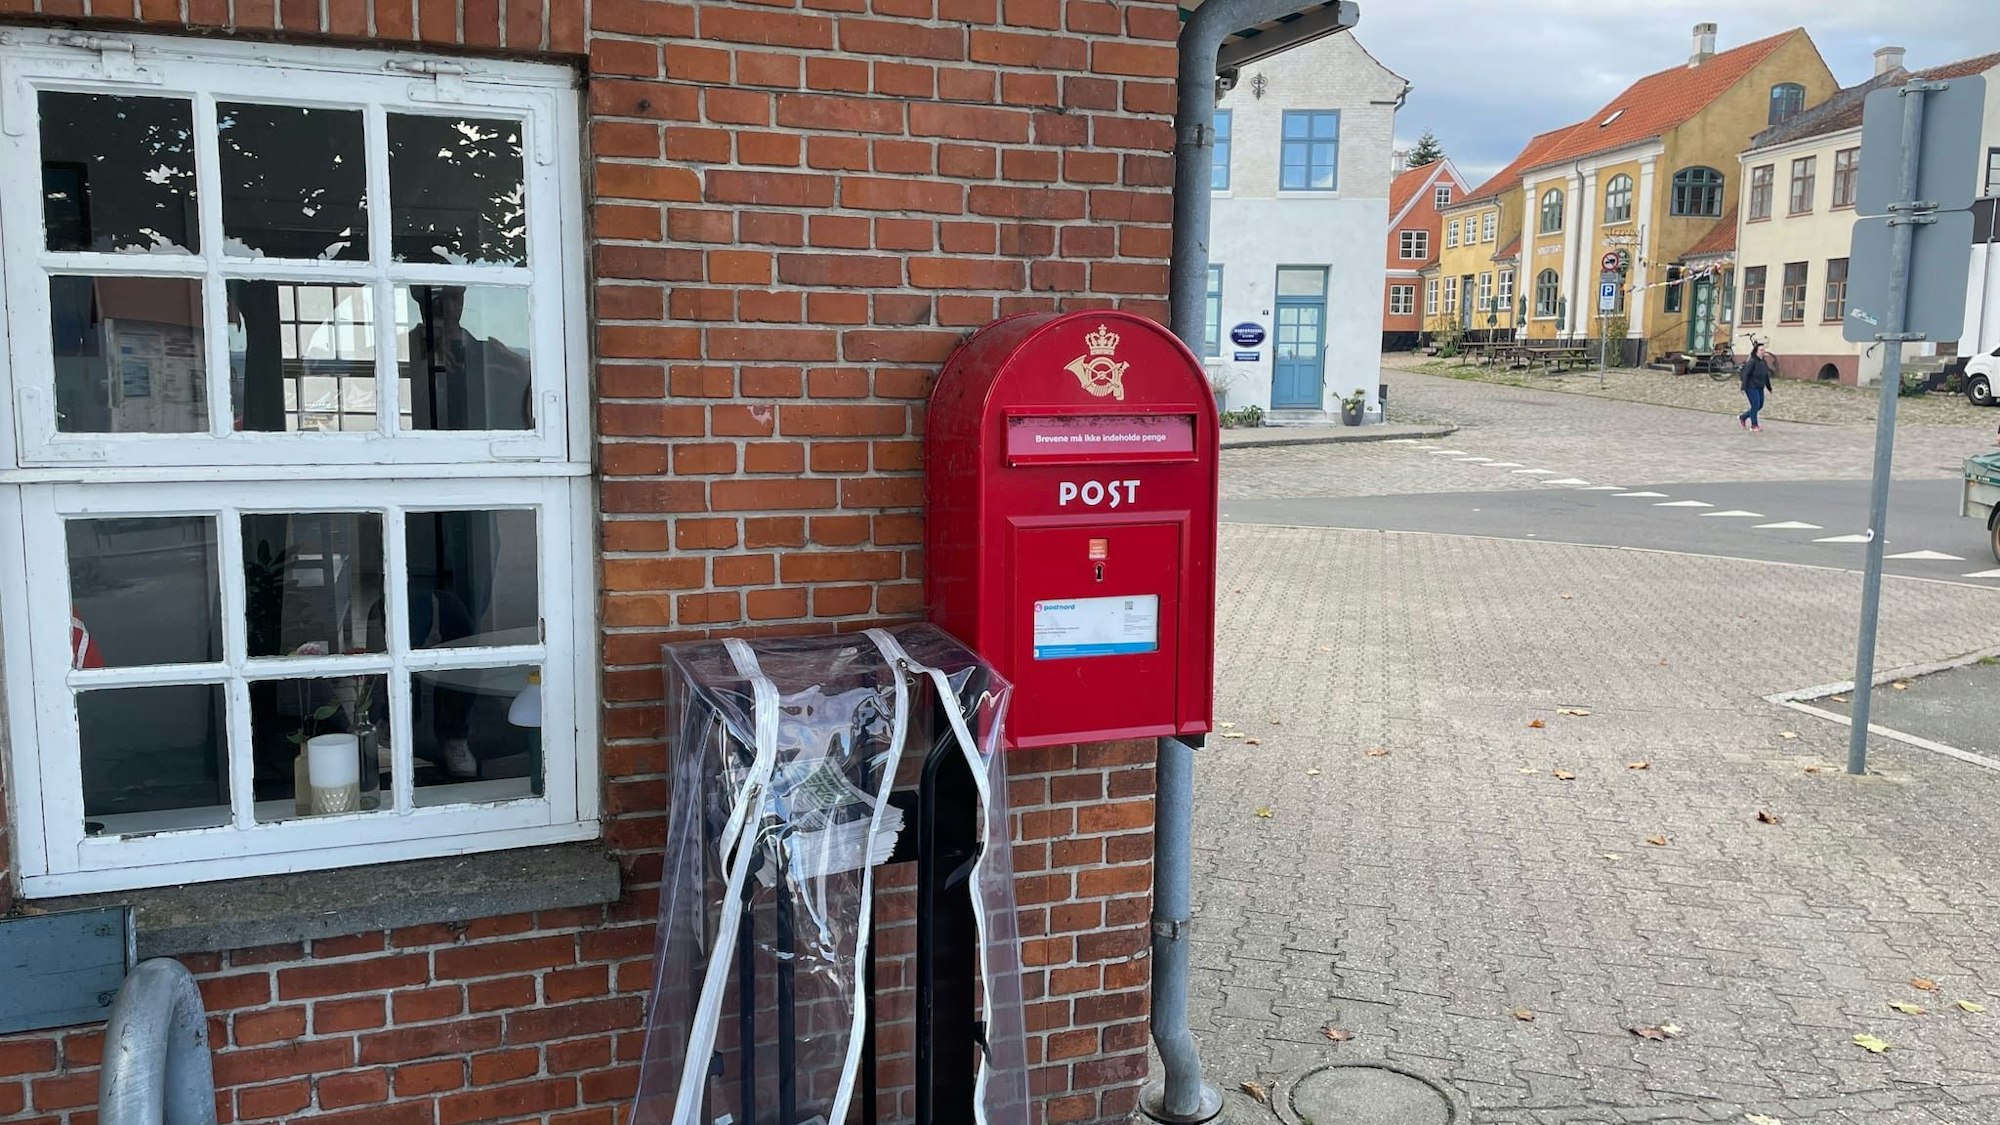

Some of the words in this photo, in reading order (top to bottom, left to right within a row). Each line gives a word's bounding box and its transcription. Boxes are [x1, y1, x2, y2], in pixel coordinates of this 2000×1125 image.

[1604, 286, 1612, 296] P
[1035, 434, 1069, 443] Brevene
[1070, 433, 1083, 443] må
[1102, 433, 1141, 442] indeholde
[1142, 434, 1167, 443] penge
[1059, 480, 1141, 508] POST
